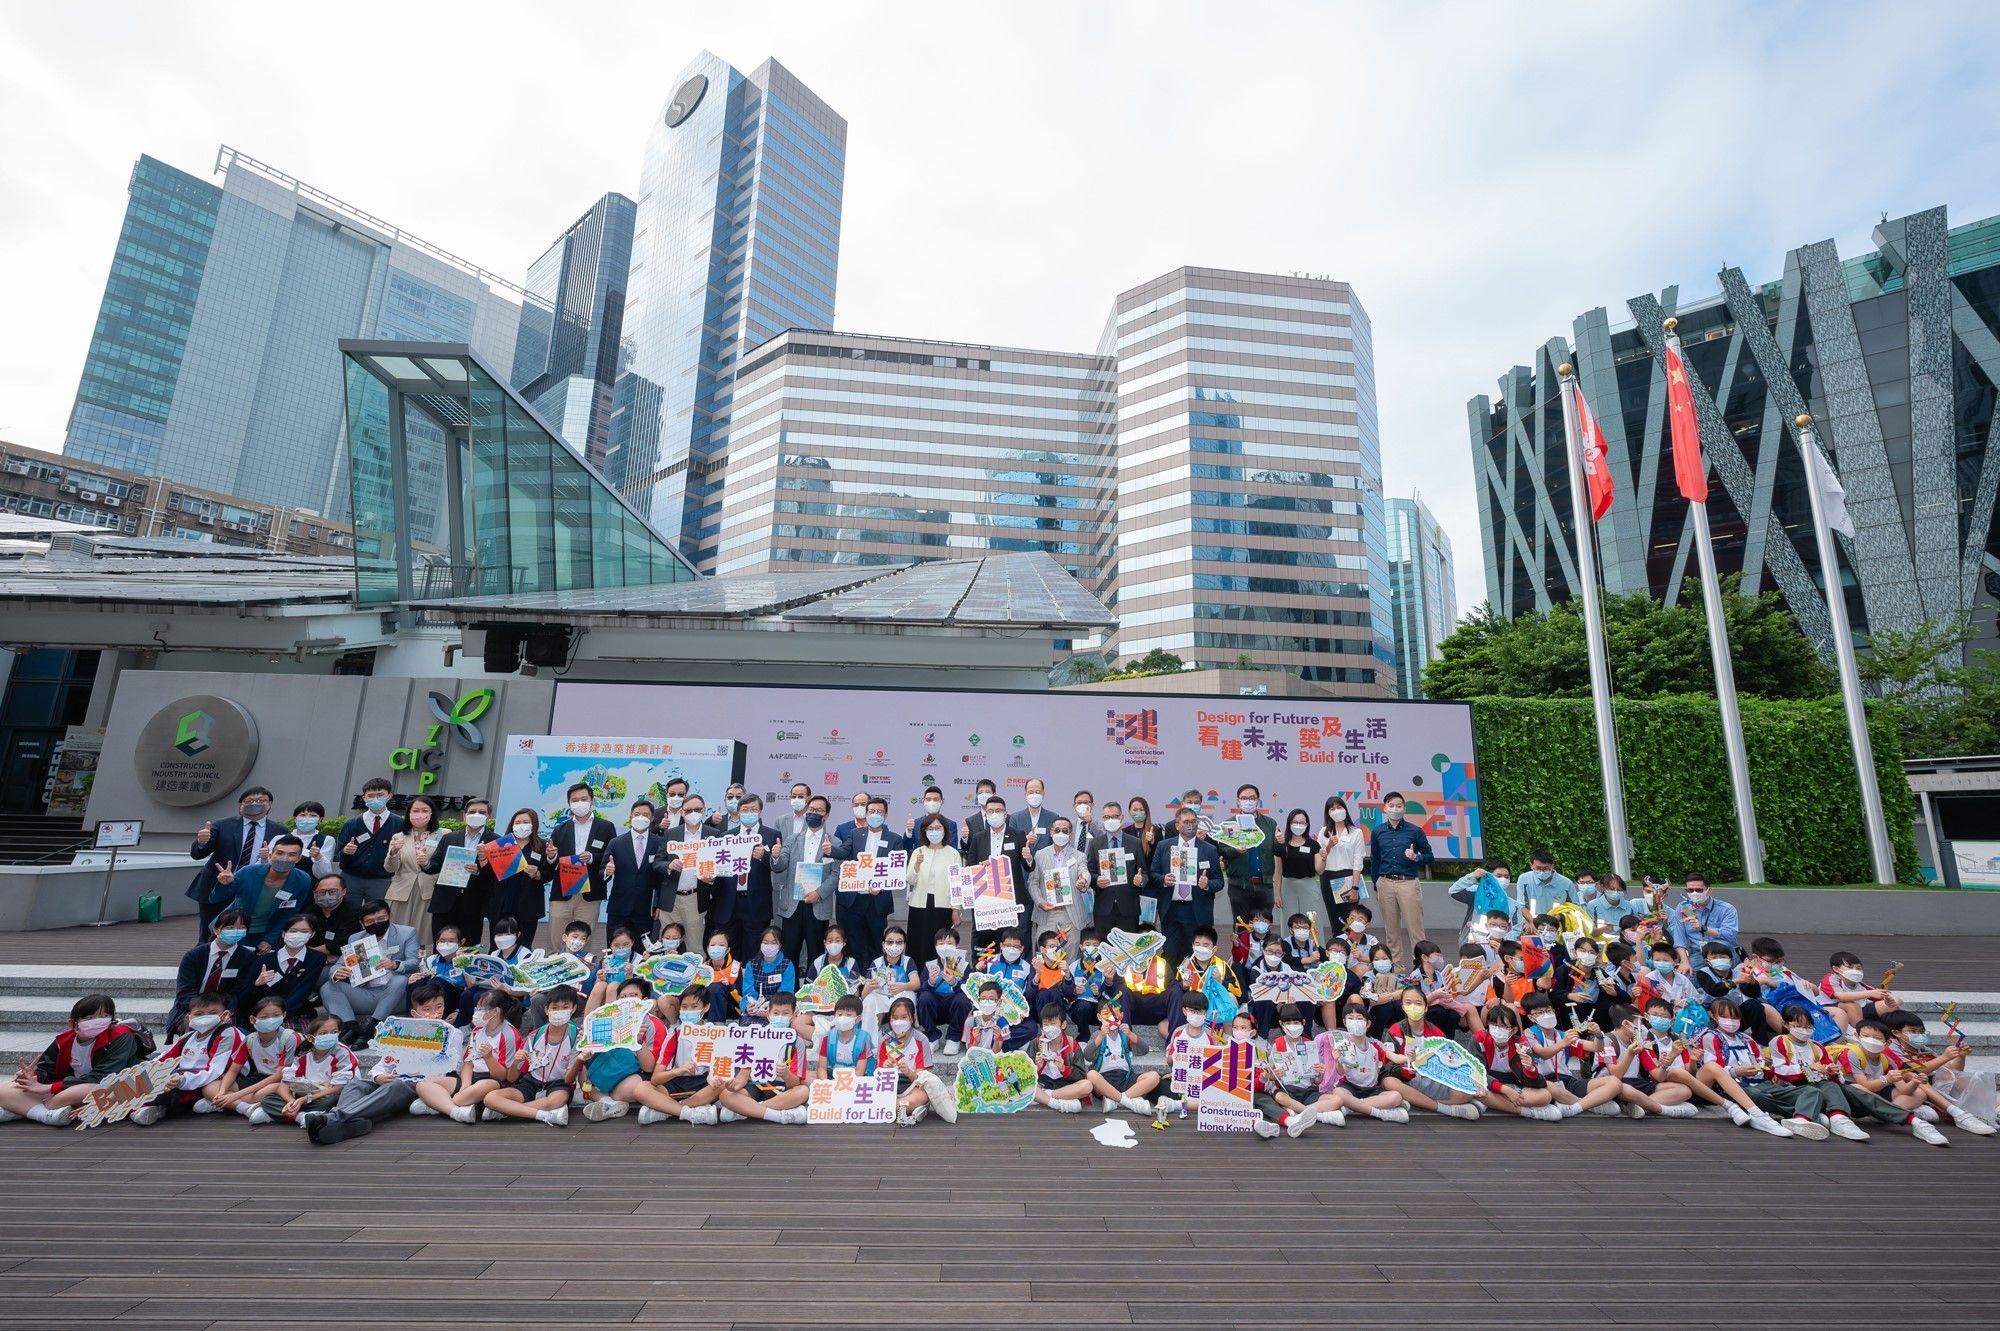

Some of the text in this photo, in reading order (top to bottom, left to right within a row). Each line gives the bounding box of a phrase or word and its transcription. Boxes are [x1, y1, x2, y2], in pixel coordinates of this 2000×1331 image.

[1197, 711, 1320, 725] Design for Future
[1198, 716, 1387, 762] 看建未來 築及生活
[565, 742, 673, 755] 香港建造業推廣計劃
[1300, 751, 1390, 764] Build for Life
[160, 762, 215, 770] CONSTRUCTION
[151, 770, 220, 779] INDUSTRY COUNCIL
[154, 780, 212, 793] 建造業議會
[669, 834, 761, 852] Design for Future
[681, 849, 748, 878] 看建未來
[842, 852, 906, 879] 築及生活
[840, 877, 905, 890] Build for Life
[976, 905, 1023, 917] Construction
[977, 918, 1017, 930] Hong Kong
[683, 1025, 793, 1040] Design for Future
[694, 1042, 775, 1079] 看建未來
[91, 1073, 148, 1112] BIM
[811, 1070, 896, 1104] 築及生活
[809, 1107, 893, 1121] Build for Life
[1200, 1105, 1261, 1118] Construction
[1200, 1122, 1224, 1131] Hong
